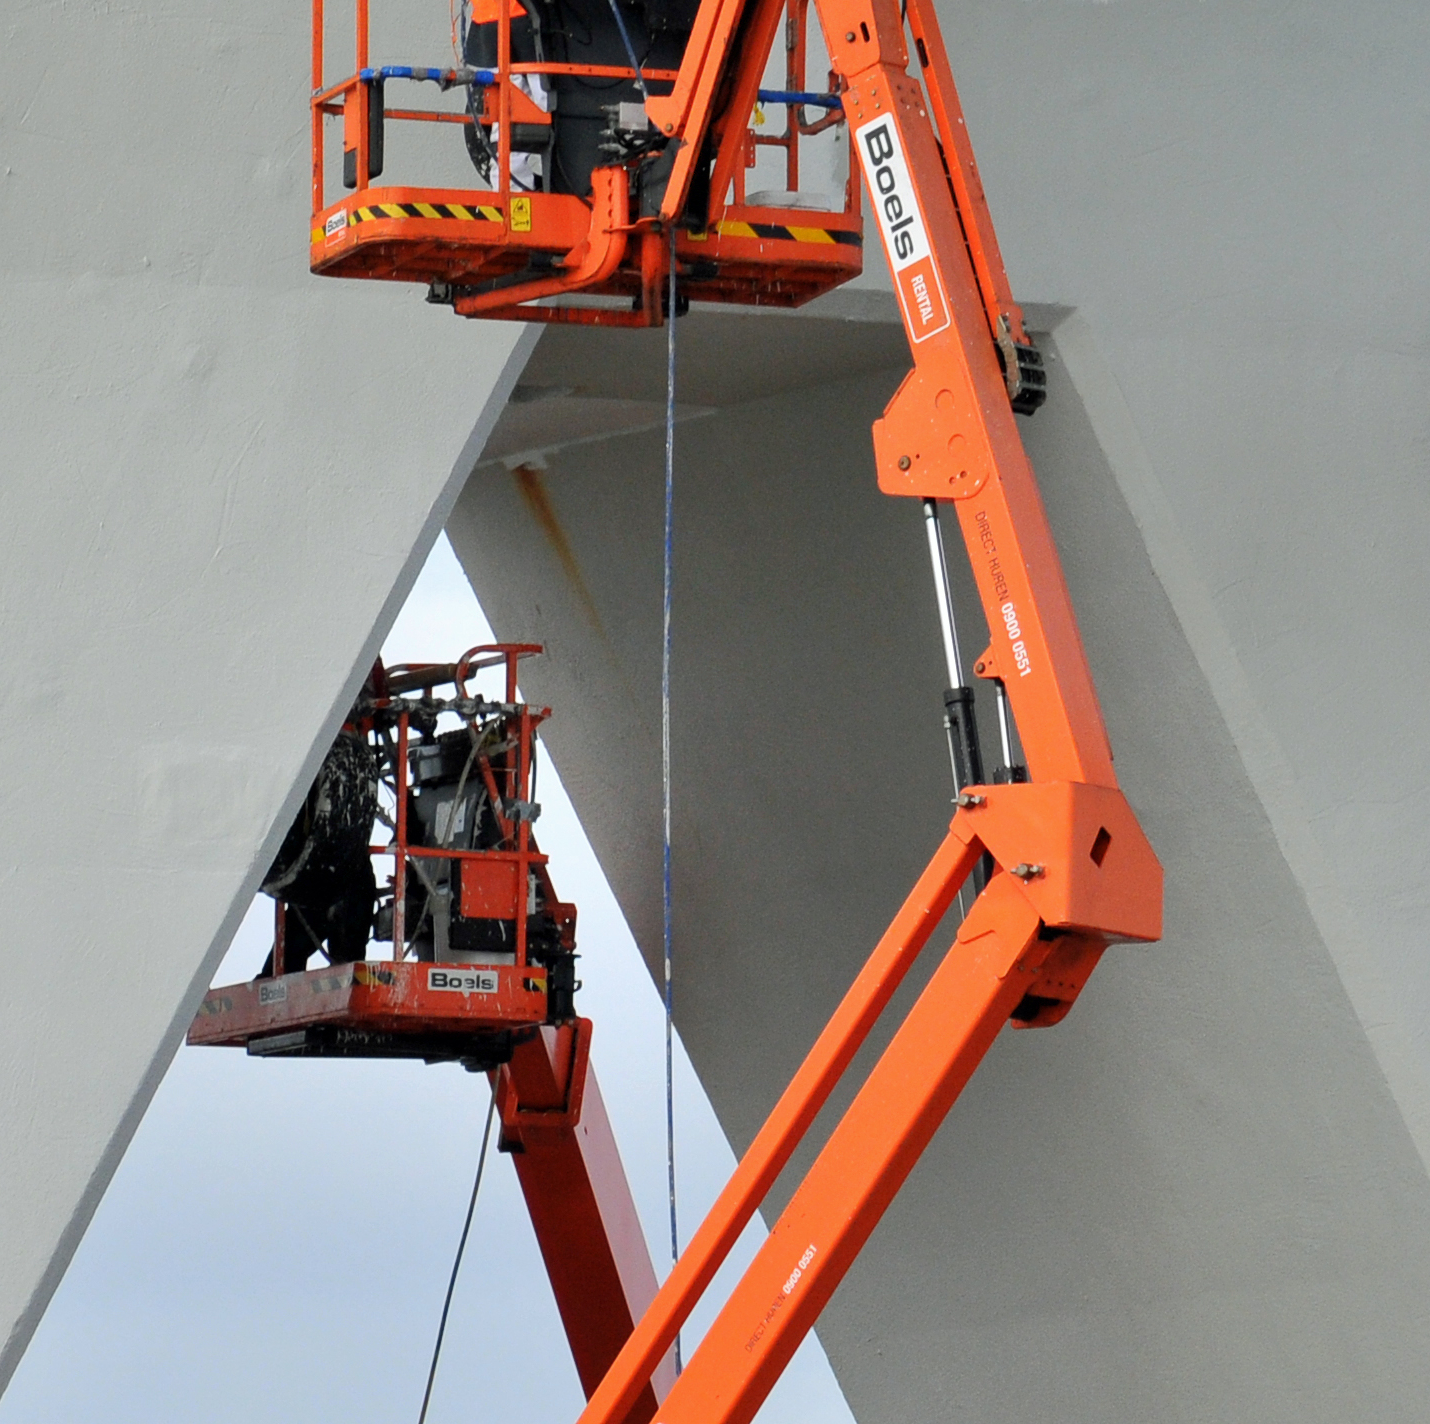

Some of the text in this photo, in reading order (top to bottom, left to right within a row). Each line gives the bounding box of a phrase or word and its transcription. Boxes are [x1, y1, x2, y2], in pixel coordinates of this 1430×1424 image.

[864, 123, 934, 325] Boels RENTAL
[975, 510, 1031, 677] DIRECT HUREN 0900 0551
[431, 972, 494, 990] Boels
[782, 1267, 801, 1294] 0900
[798, 1243, 817, 1270] 0551
